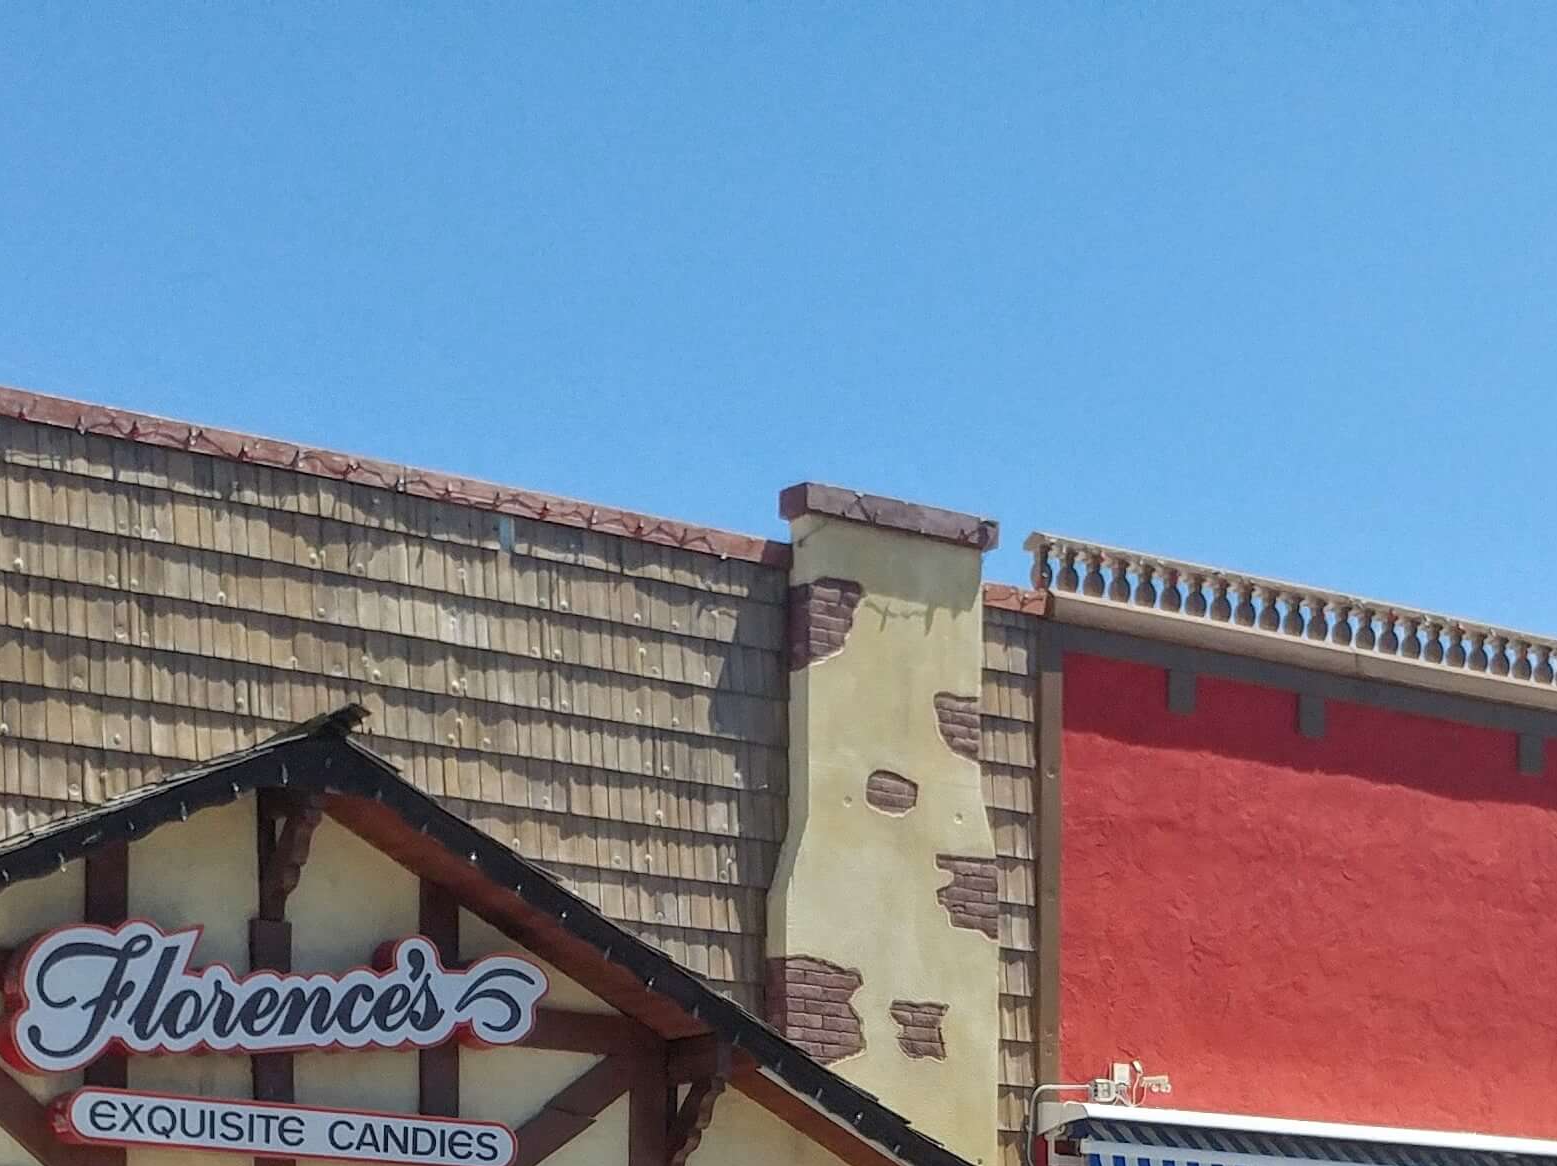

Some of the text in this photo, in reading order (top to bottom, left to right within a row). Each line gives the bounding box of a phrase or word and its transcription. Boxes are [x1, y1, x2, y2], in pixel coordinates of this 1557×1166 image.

[28, 933, 535, 1058] Florence's
[89, 1099, 499, 1162] EXQUISITE CANDIES
